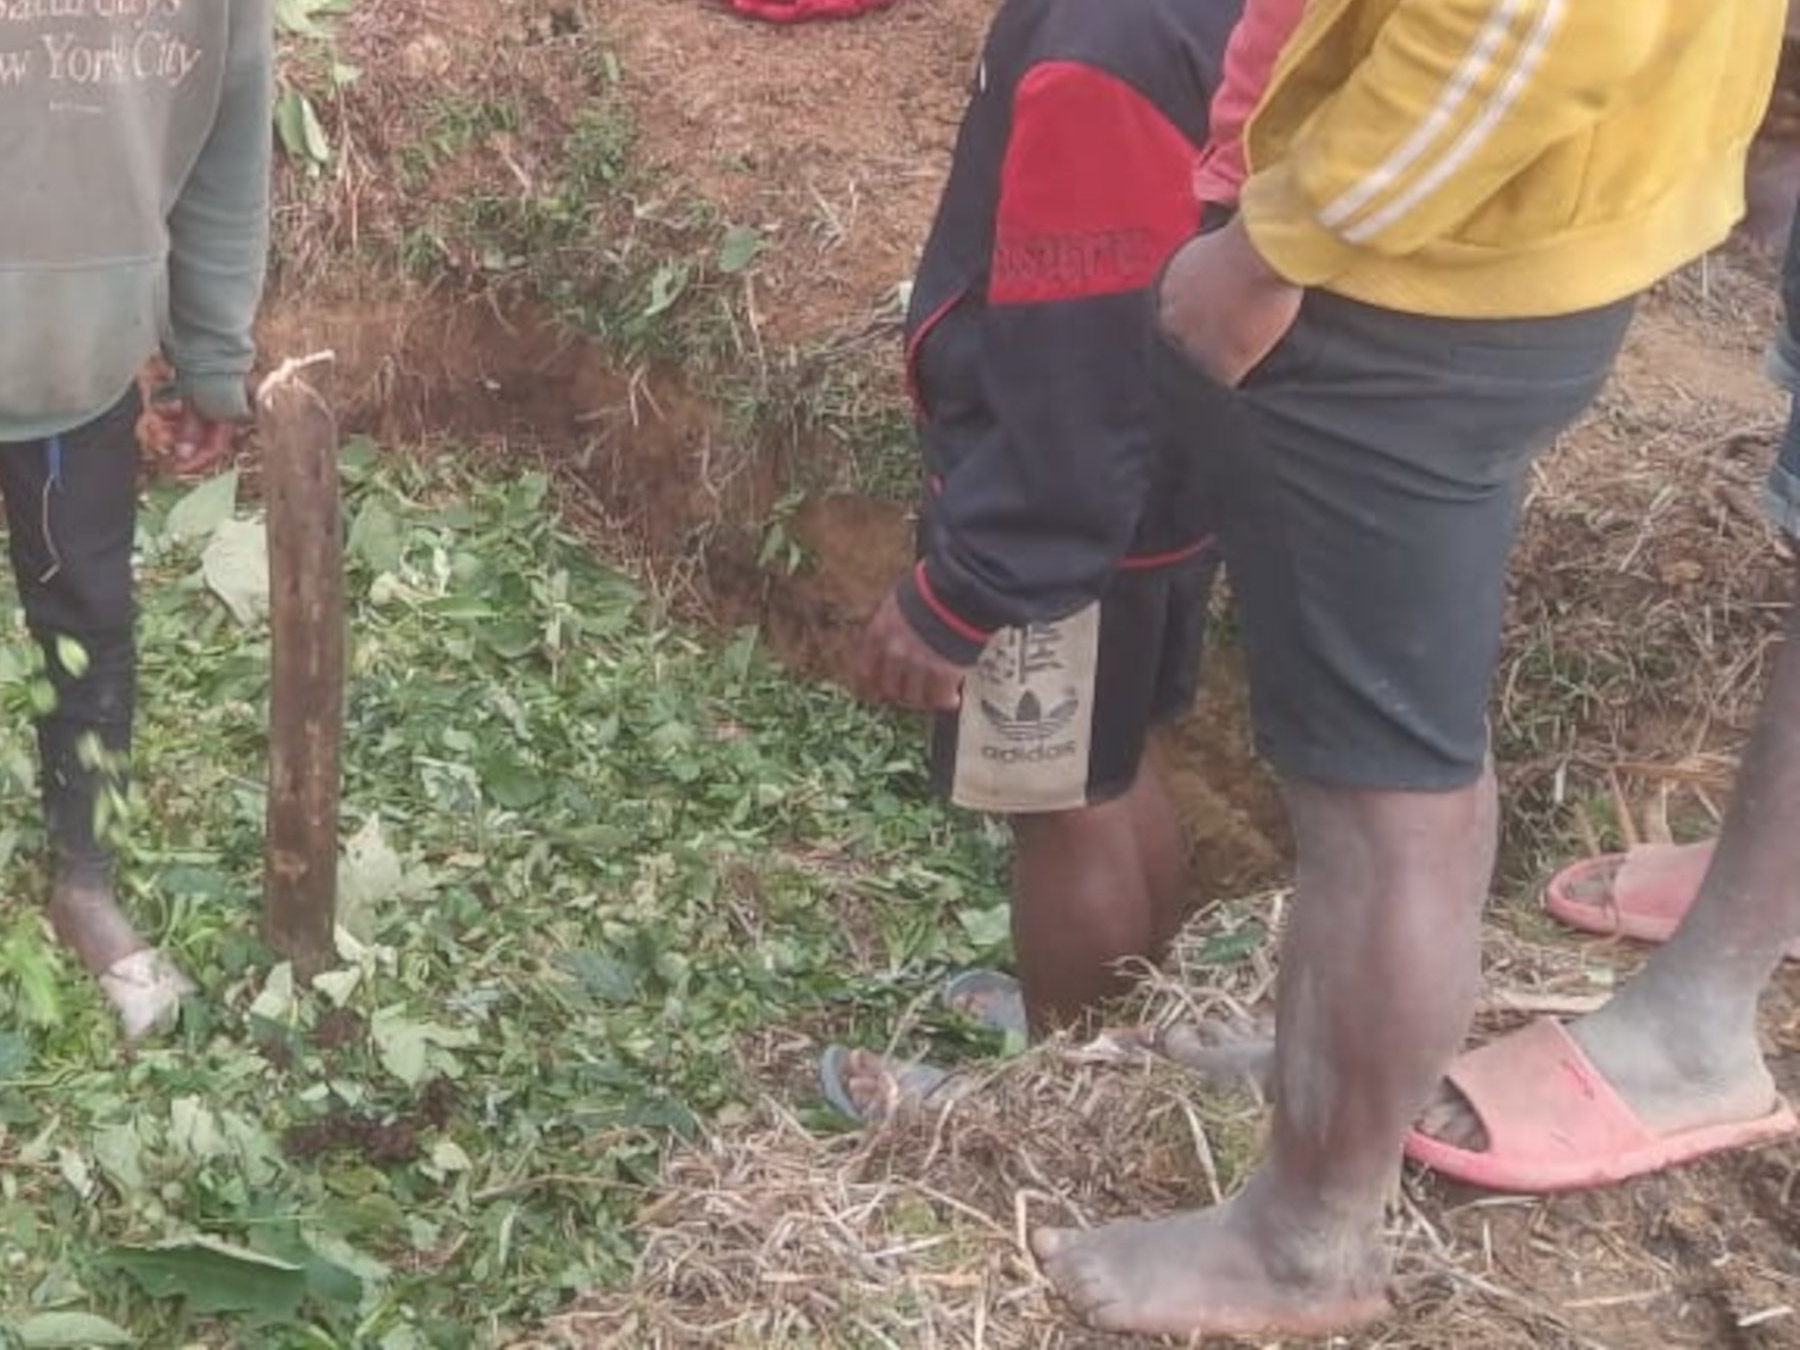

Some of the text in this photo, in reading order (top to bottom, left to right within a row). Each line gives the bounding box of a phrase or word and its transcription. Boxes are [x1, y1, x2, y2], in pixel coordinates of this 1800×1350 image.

[38, 32, 125, 83] York
[132, 29, 201, 88] City
[979, 734, 1078, 763] adidas
